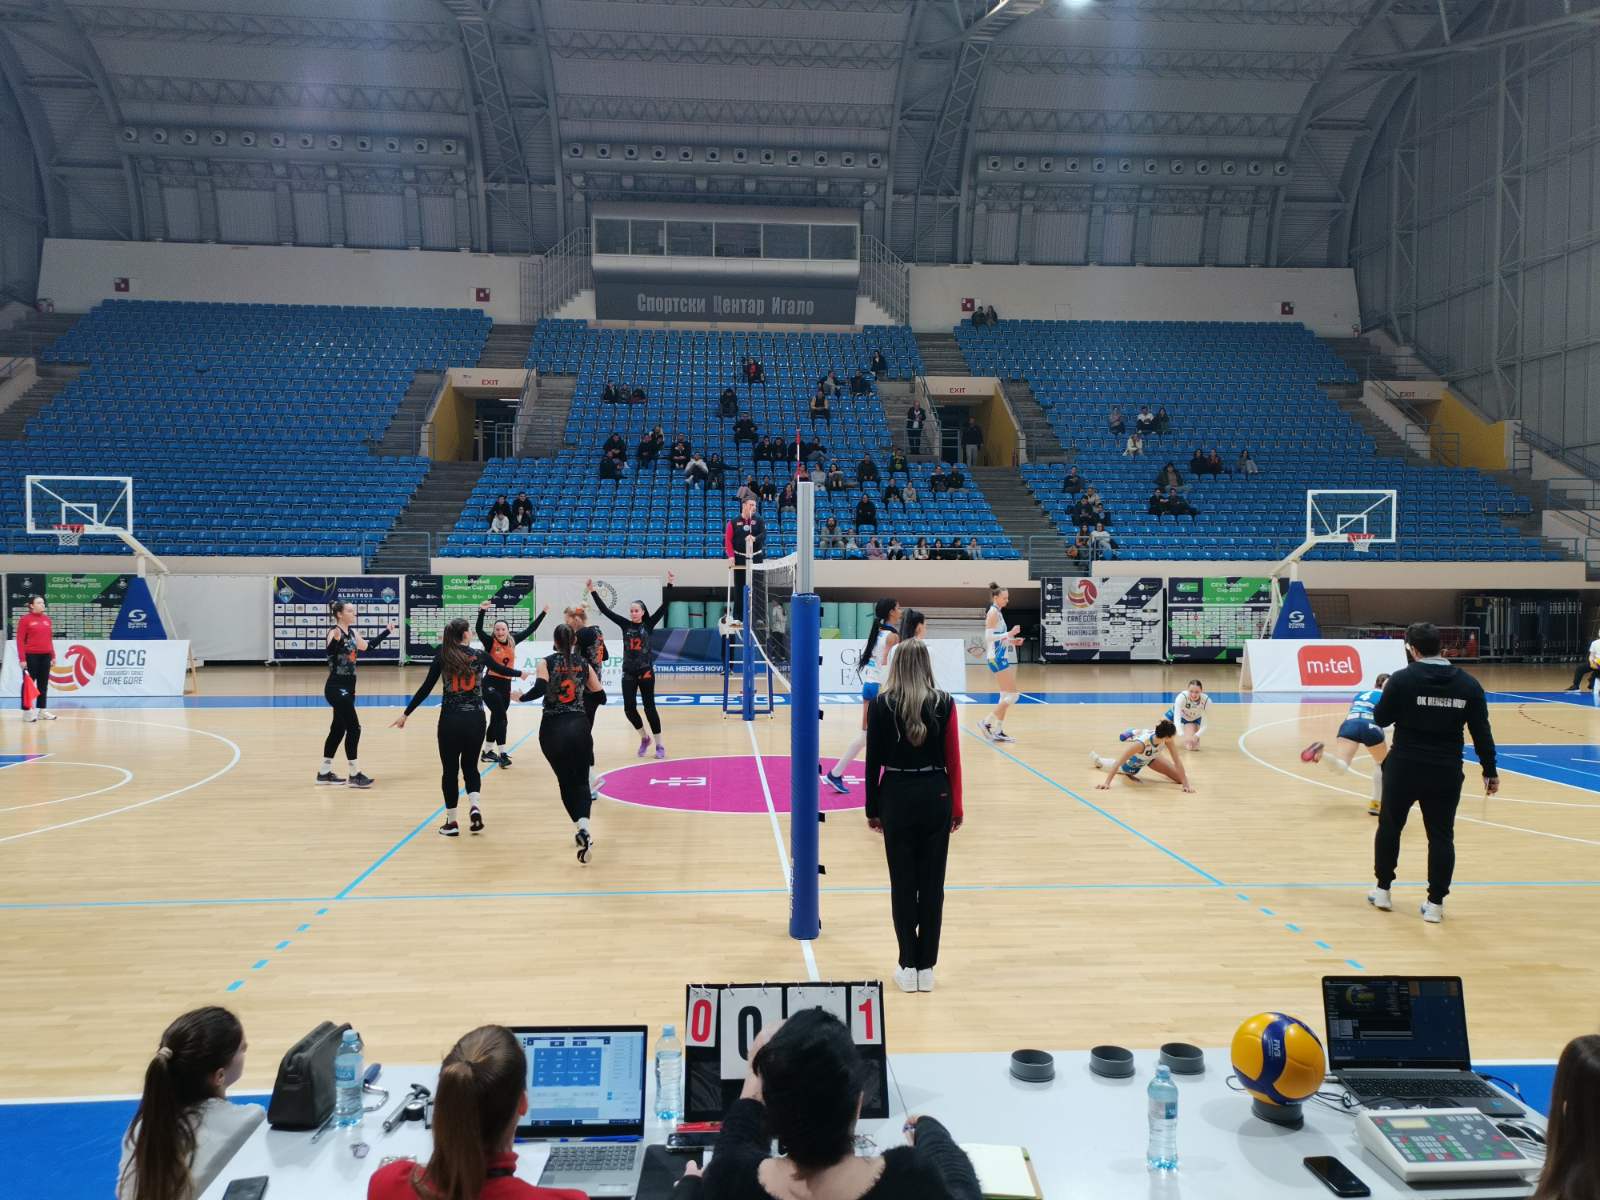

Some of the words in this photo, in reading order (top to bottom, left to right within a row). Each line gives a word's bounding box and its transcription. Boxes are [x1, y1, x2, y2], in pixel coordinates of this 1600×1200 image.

[637, 293, 706, 315] Спортски
[713, 296, 765, 316] Центар
[772, 297, 815, 316] Игало
[629, 638, 642, 651] 12
[105, 649, 146, 666] OSCG
[1306, 656, 1354, 675] m:tel
[653, 664, 674, 672] ŠTINA
[102, 676, 122, 685] CRNE
[123, 676, 143, 685] GORE
[559, 679, 577, 704] 3
[1416, 696, 1427, 706] OK
[691, 999, 712, 1043] 0
[858, 998, 874, 1040] 1
[738, 1006, 763, 1061] 0
